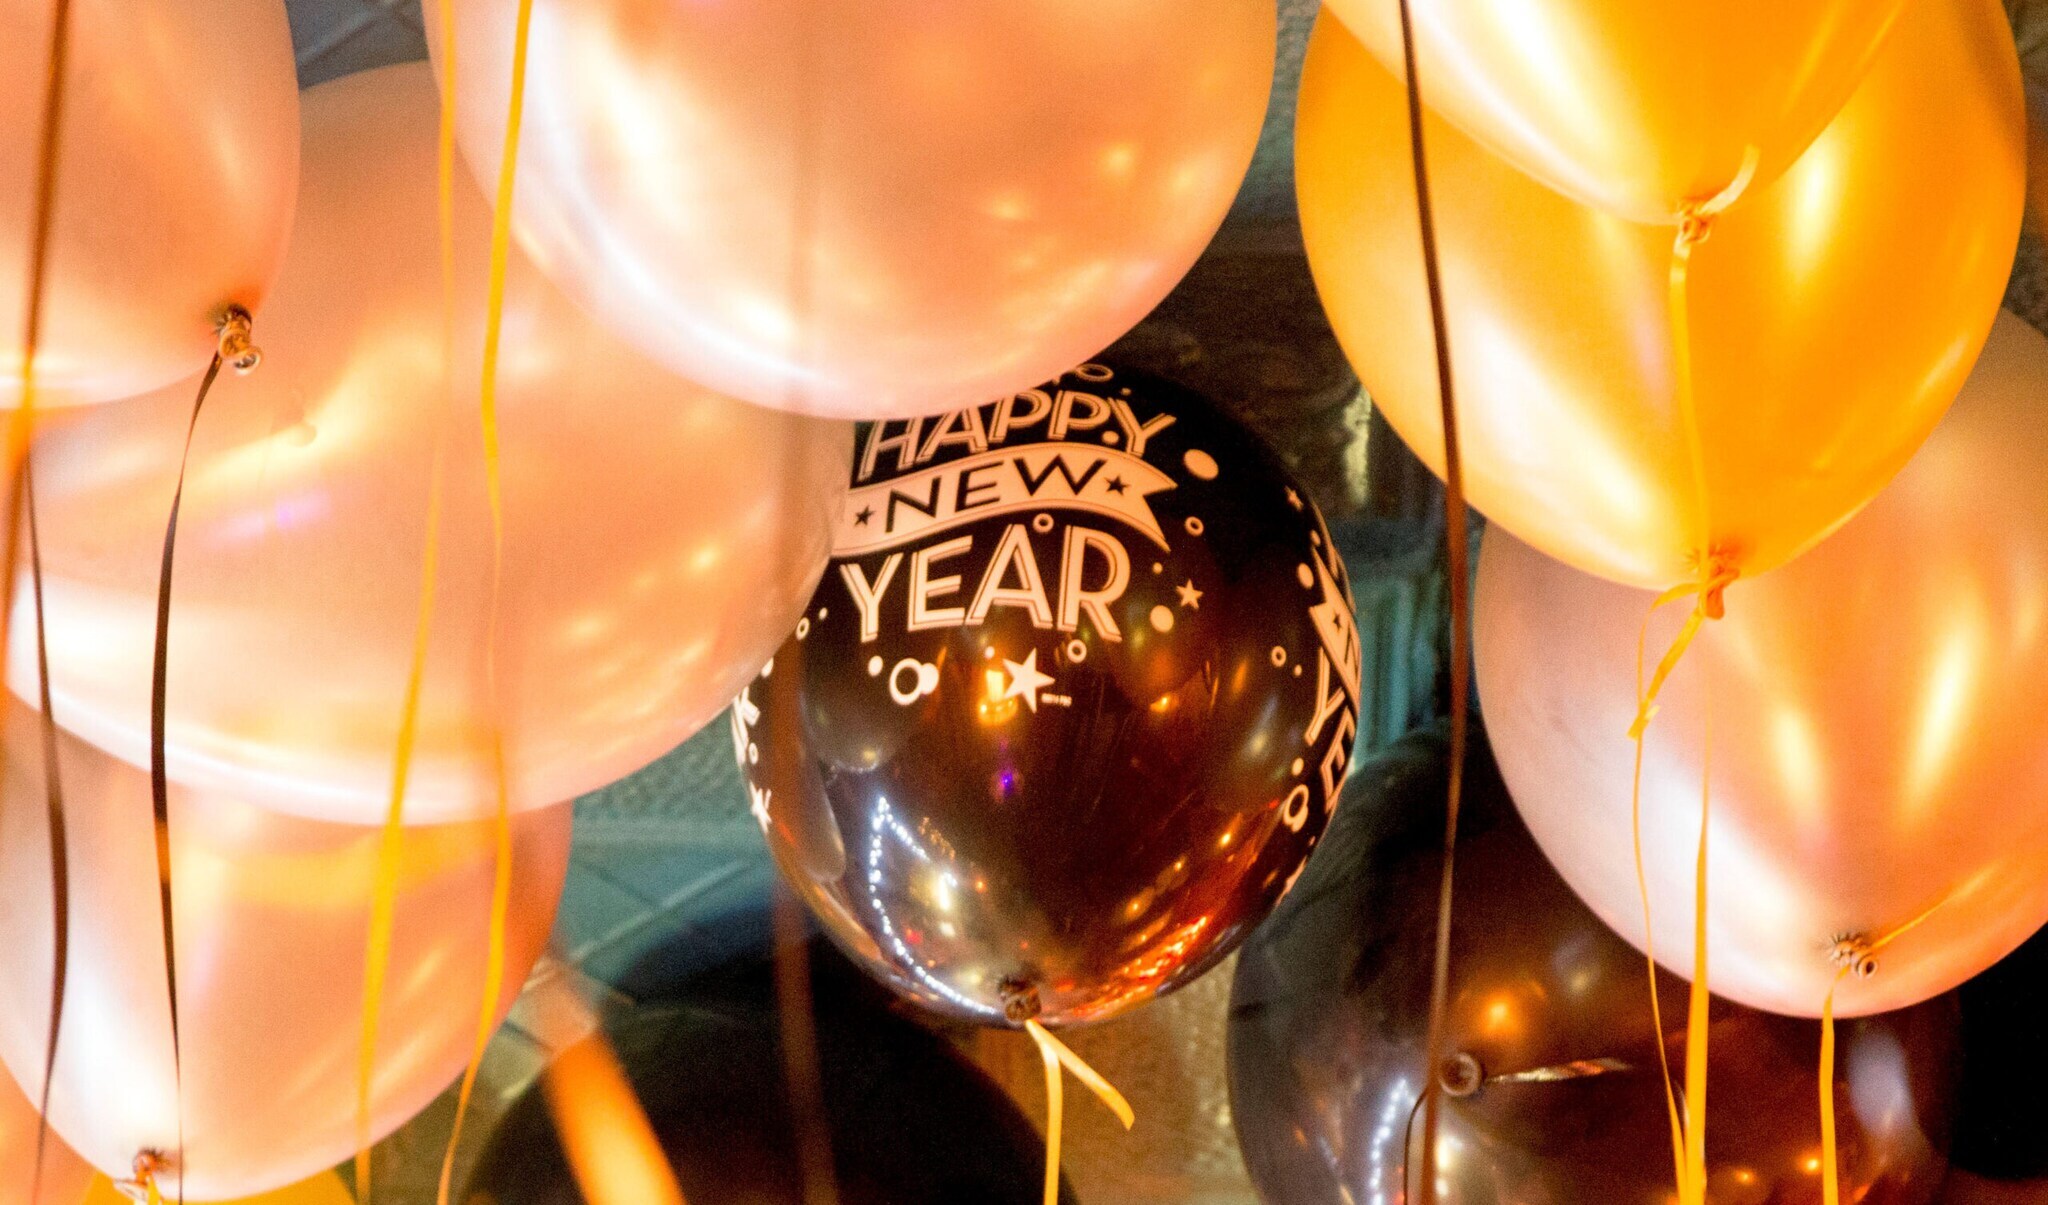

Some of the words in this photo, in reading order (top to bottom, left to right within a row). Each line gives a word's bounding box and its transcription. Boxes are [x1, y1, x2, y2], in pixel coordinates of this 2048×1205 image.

[857, 388, 1177, 482] HAPPY
[885, 453, 1108, 534] NEW
[839, 523, 1131, 643] YEAR
